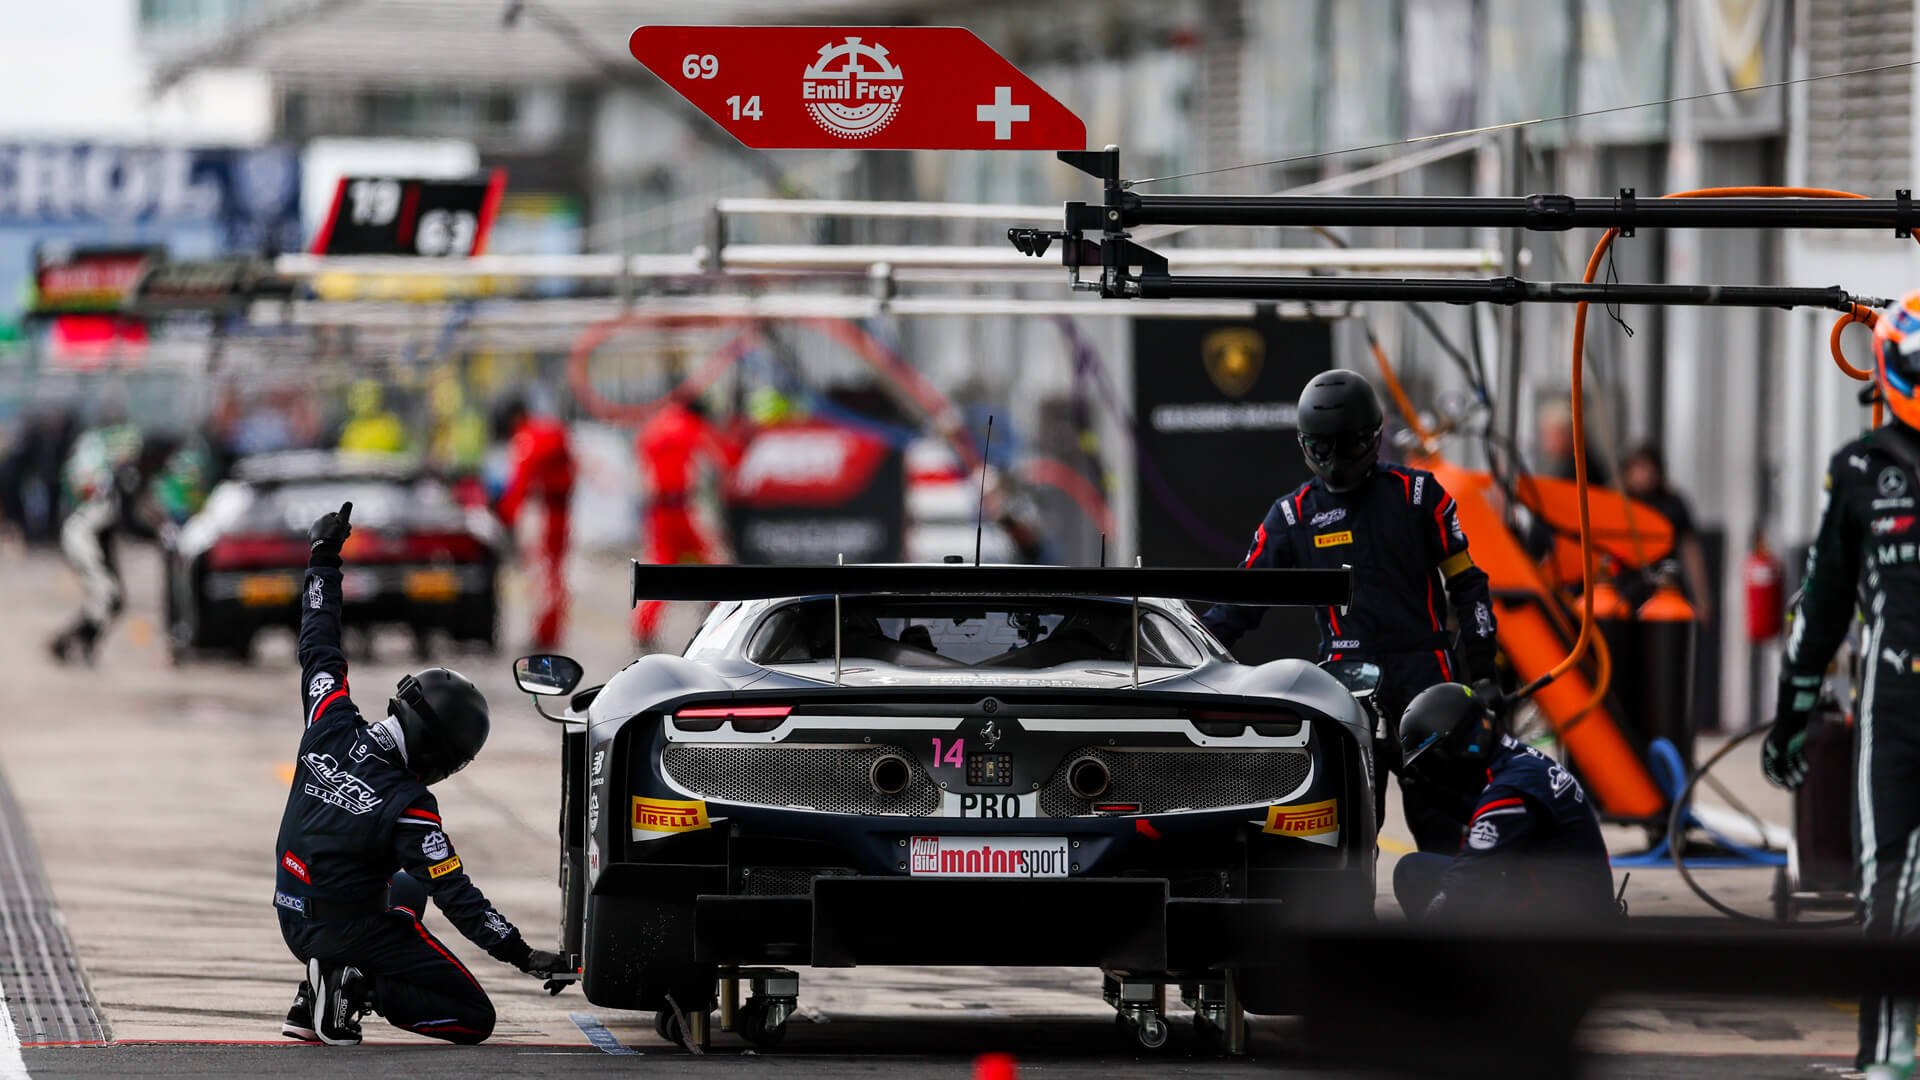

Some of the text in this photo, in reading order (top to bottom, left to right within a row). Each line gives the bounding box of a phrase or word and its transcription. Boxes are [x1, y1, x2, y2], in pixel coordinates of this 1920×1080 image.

[682, 55, 719, 79] 69
[803, 80, 904, 102] Emil Frey
[726, 96, 763, 120] 14
[349, 181, 401, 226] 19
[932, 738, 965, 768] 14
[307, 752, 383, 809] Emil Frey
[635, 803, 700, 827] PIRELLI
[960, 793, 1021, 819] PRO
[1273, 806, 1334, 832] PIRELLI
[913, 838, 938, 856] Auto
[913, 855, 938, 872] Bild
[941, 846, 1067, 879] motorsport
[339, 998, 349, 1029] sparco
